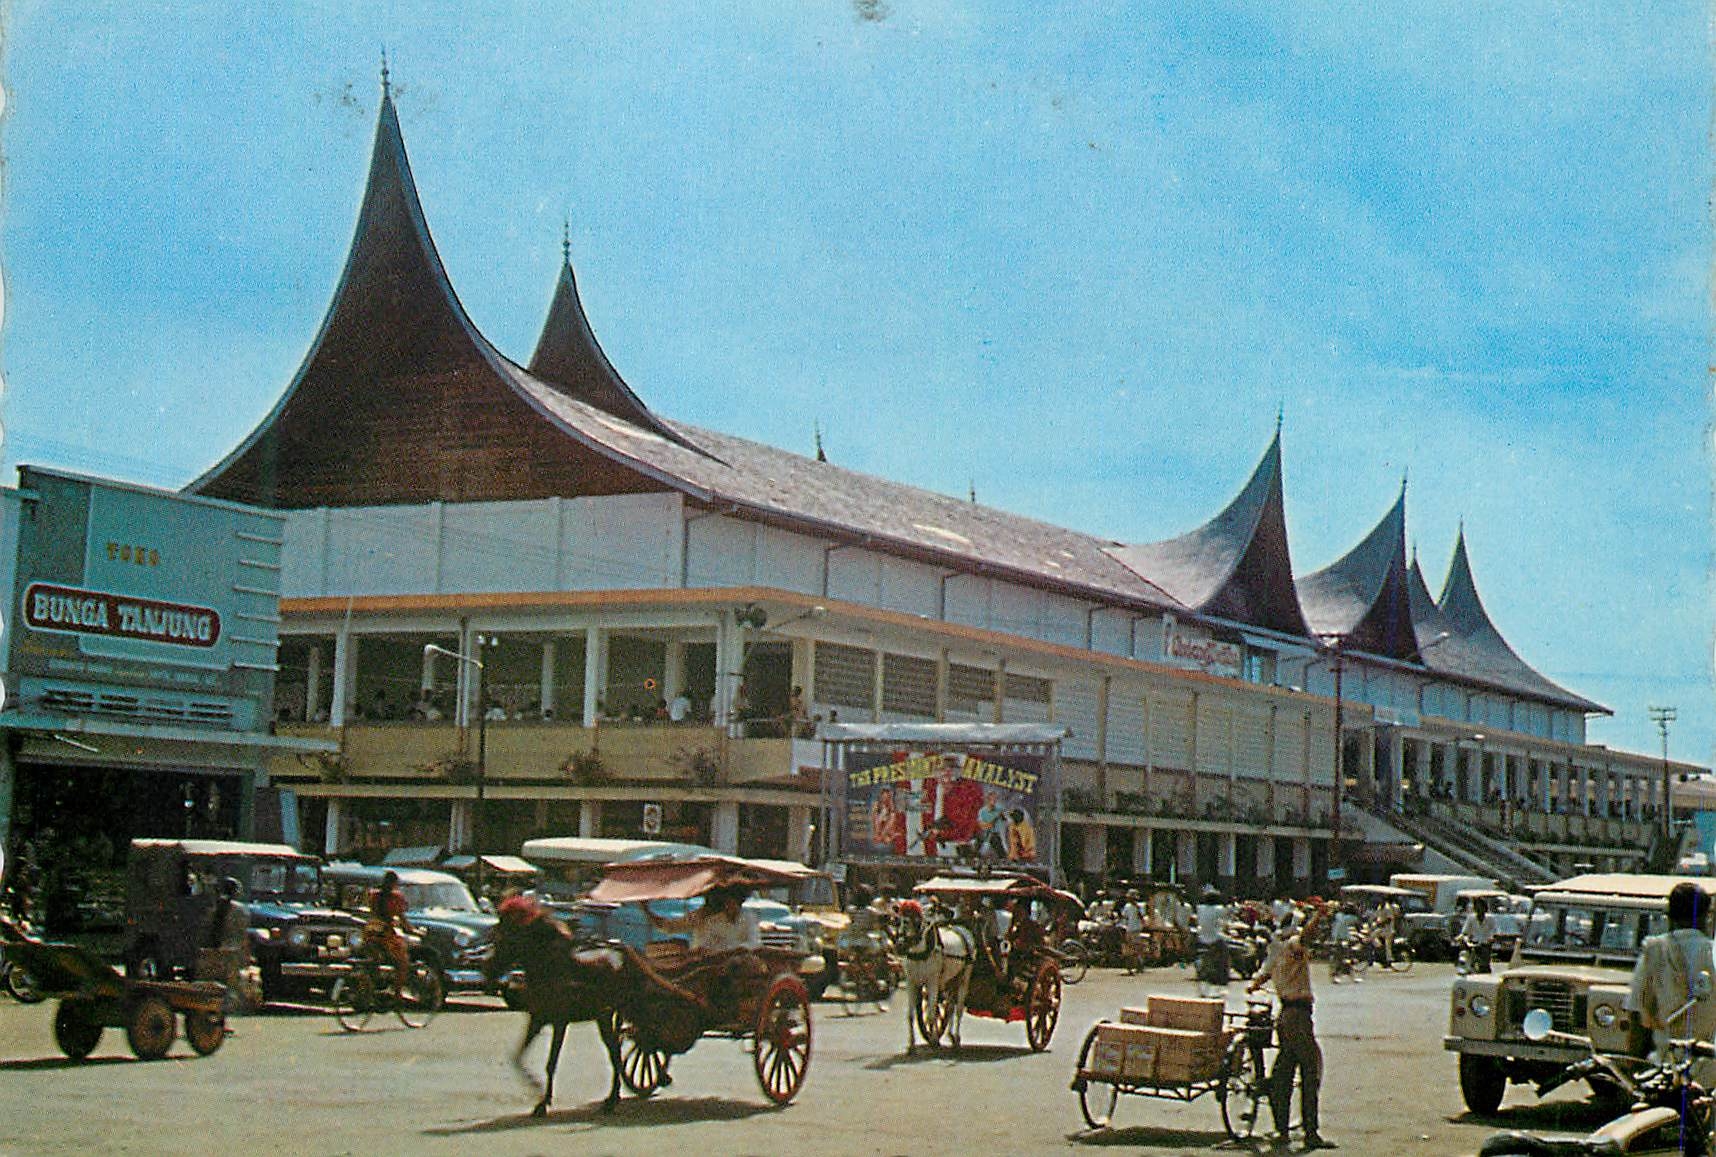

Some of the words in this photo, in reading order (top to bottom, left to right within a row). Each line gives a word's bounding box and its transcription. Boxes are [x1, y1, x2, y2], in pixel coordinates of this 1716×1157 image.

[106, 543, 160, 566] TOKO
[33, 593, 109, 629] BUNGA
[118, 604, 211, 641] TANJUNG
